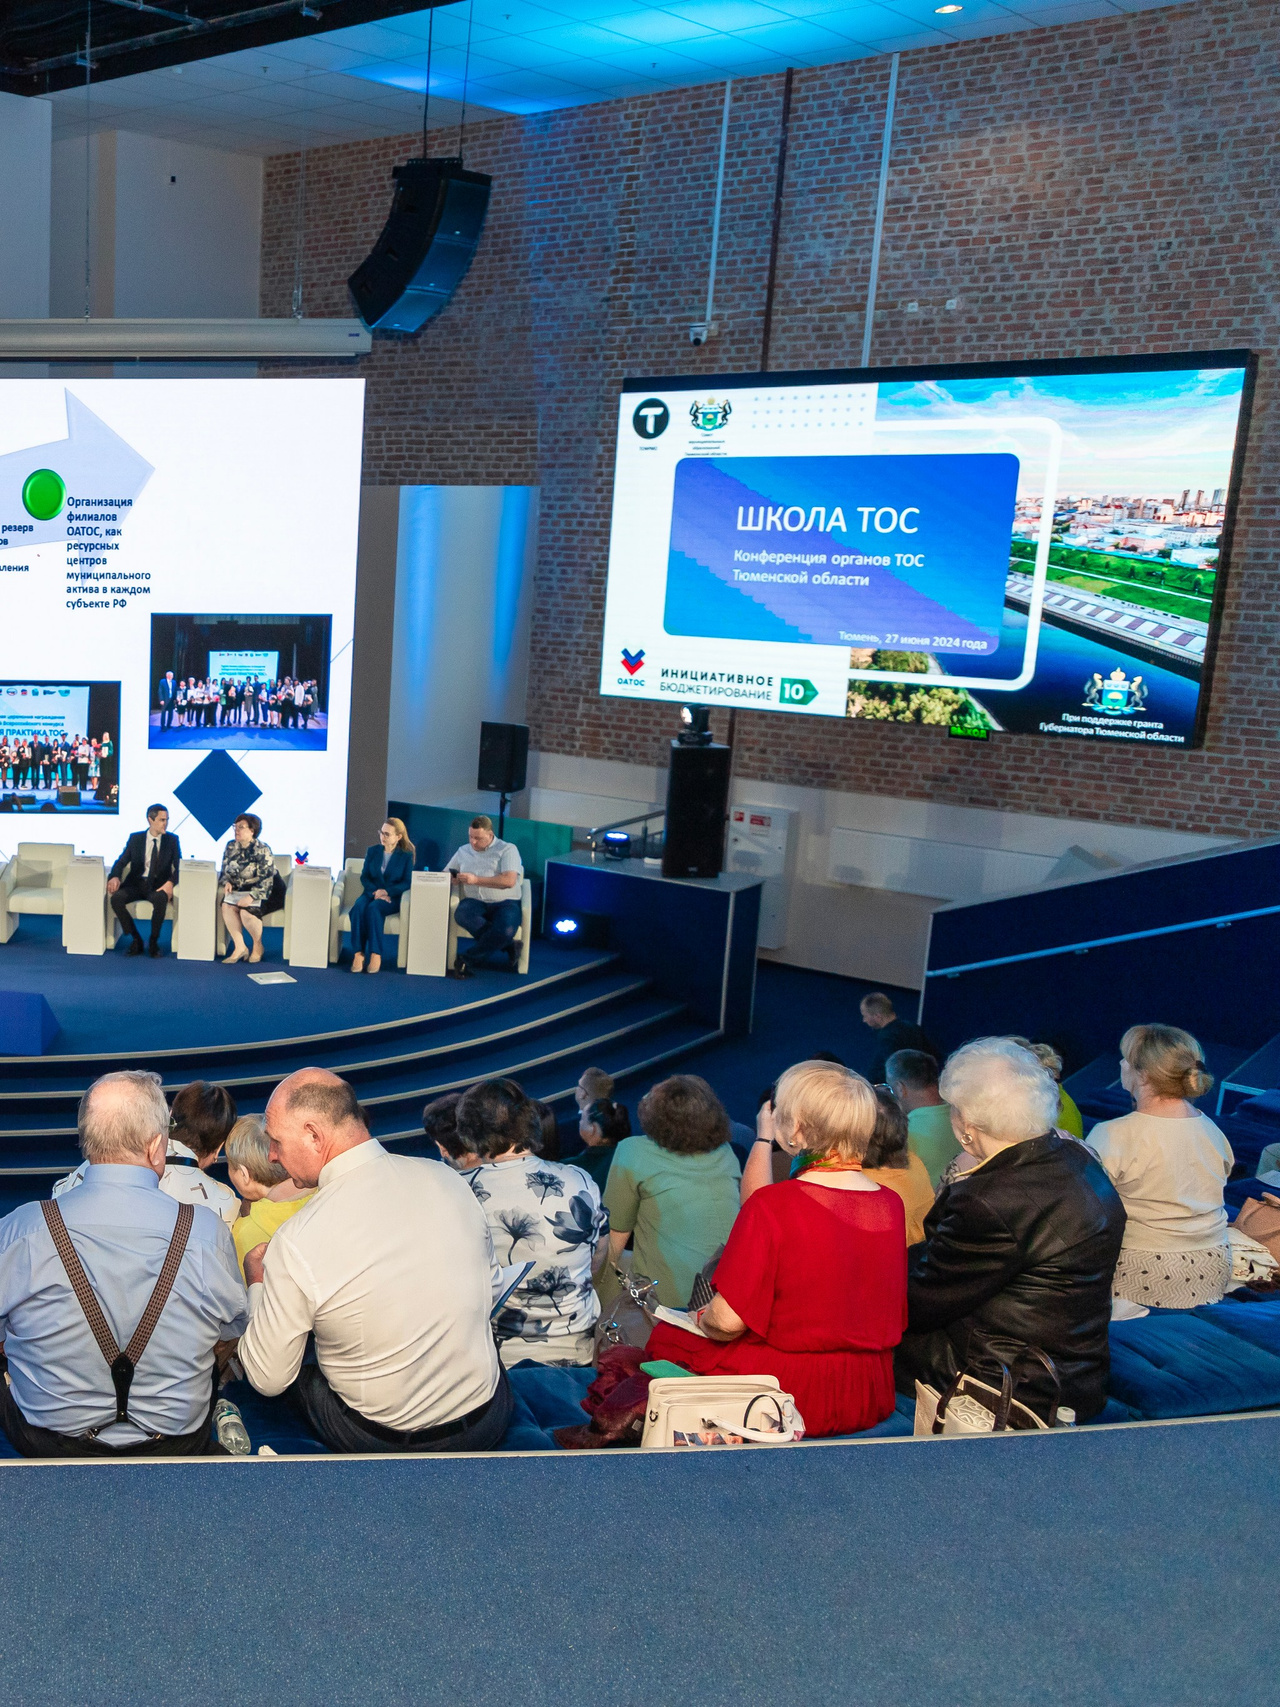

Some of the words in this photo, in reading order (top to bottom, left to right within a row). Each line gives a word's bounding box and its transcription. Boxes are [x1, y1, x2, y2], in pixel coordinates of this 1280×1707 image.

[67, 497, 132, 508] Организация
[67, 512, 117, 522] филиалов
[736, 506, 847, 532] ШКОЛА
[857, 506, 920, 533] ТОС
[2, 524, 34, 533] резерв
[67, 526, 103, 538] ОАТОС,
[67, 542, 119, 552] ресурсных
[67, 557, 107, 566] центров
[734, 549, 826, 566] Конференция
[831, 553, 890, 568] органов
[894, 554, 925, 567] ТОС
[67, 572, 151, 582] муниципального
[732, 569, 808, 584] Тюменской
[812, 571, 869, 586] области
[66, 586, 100, 594] актива
[102, 586, 108, 594] в
[110, 586, 151, 596] каждом
[66, 600, 110, 610] субъекте
[113, 599, 127, 608] РФ
[839, 631, 882, 644] Тюмень,
[884, 633, 898, 644] 27
[900, 636, 930, 646] июня
[932, 636, 960, 648] 2024
[962, 639, 987, 650] года
[617, 678, 645, 686] ОАТОС
[661, 668, 774, 686] ИНИЦИАТИВНОЕ
[659, 682, 772, 700] БЮДЖЕТИРОВАНИЕ
[783, 683, 804, 700] 10
[1062, 713, 1080, 722] При
[1082, 715, 1132, 728] поддержке
[1134, 720, 1164, 730] гранта
[1039, 722, 1094, 734] Губернатора
[1095, 727, 1148, 740] Тюменской
[1148, 731, 1185, 743] области
